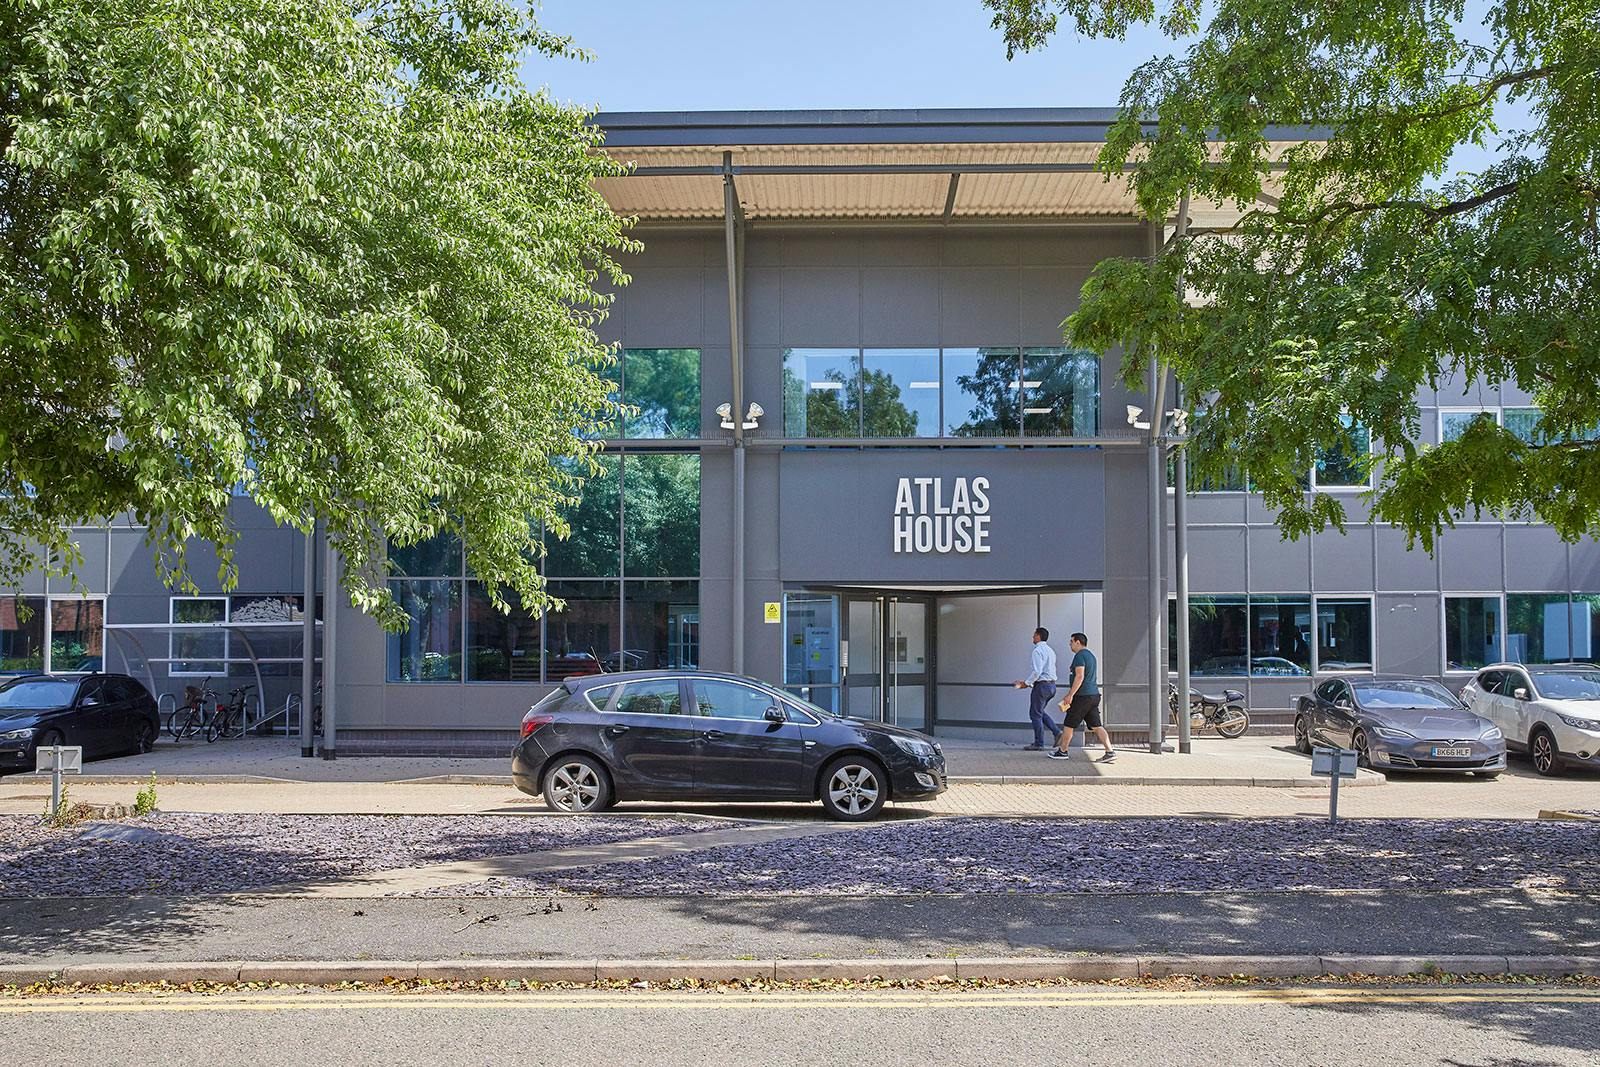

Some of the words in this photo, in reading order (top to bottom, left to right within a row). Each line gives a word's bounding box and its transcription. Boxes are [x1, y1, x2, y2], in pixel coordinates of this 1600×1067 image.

[894, 476, 990, 514] ATLAS
[893, 515, 991, 553] HOUSE
[1437, 748, 1455, 756] BK66
[1456, 748, 1470, 756] HLF
